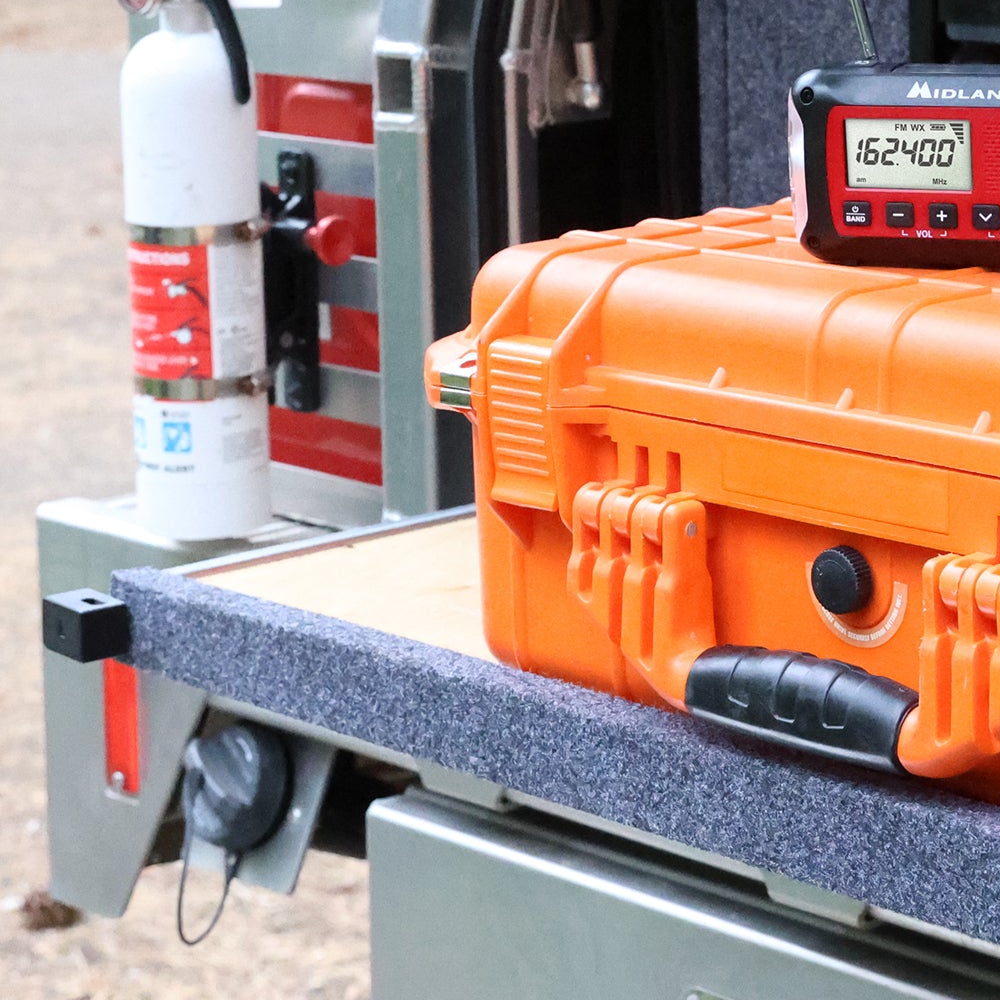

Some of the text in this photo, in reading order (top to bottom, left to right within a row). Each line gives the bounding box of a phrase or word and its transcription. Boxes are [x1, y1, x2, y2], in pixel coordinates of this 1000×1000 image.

[910, 124, 925, 132] WX
[856, 137, 956, 167] 162.400
[932, 178, 947, 186] MHz
[846, 215, 866, 223] BAND
[916, 230, 933, 238] VOL
